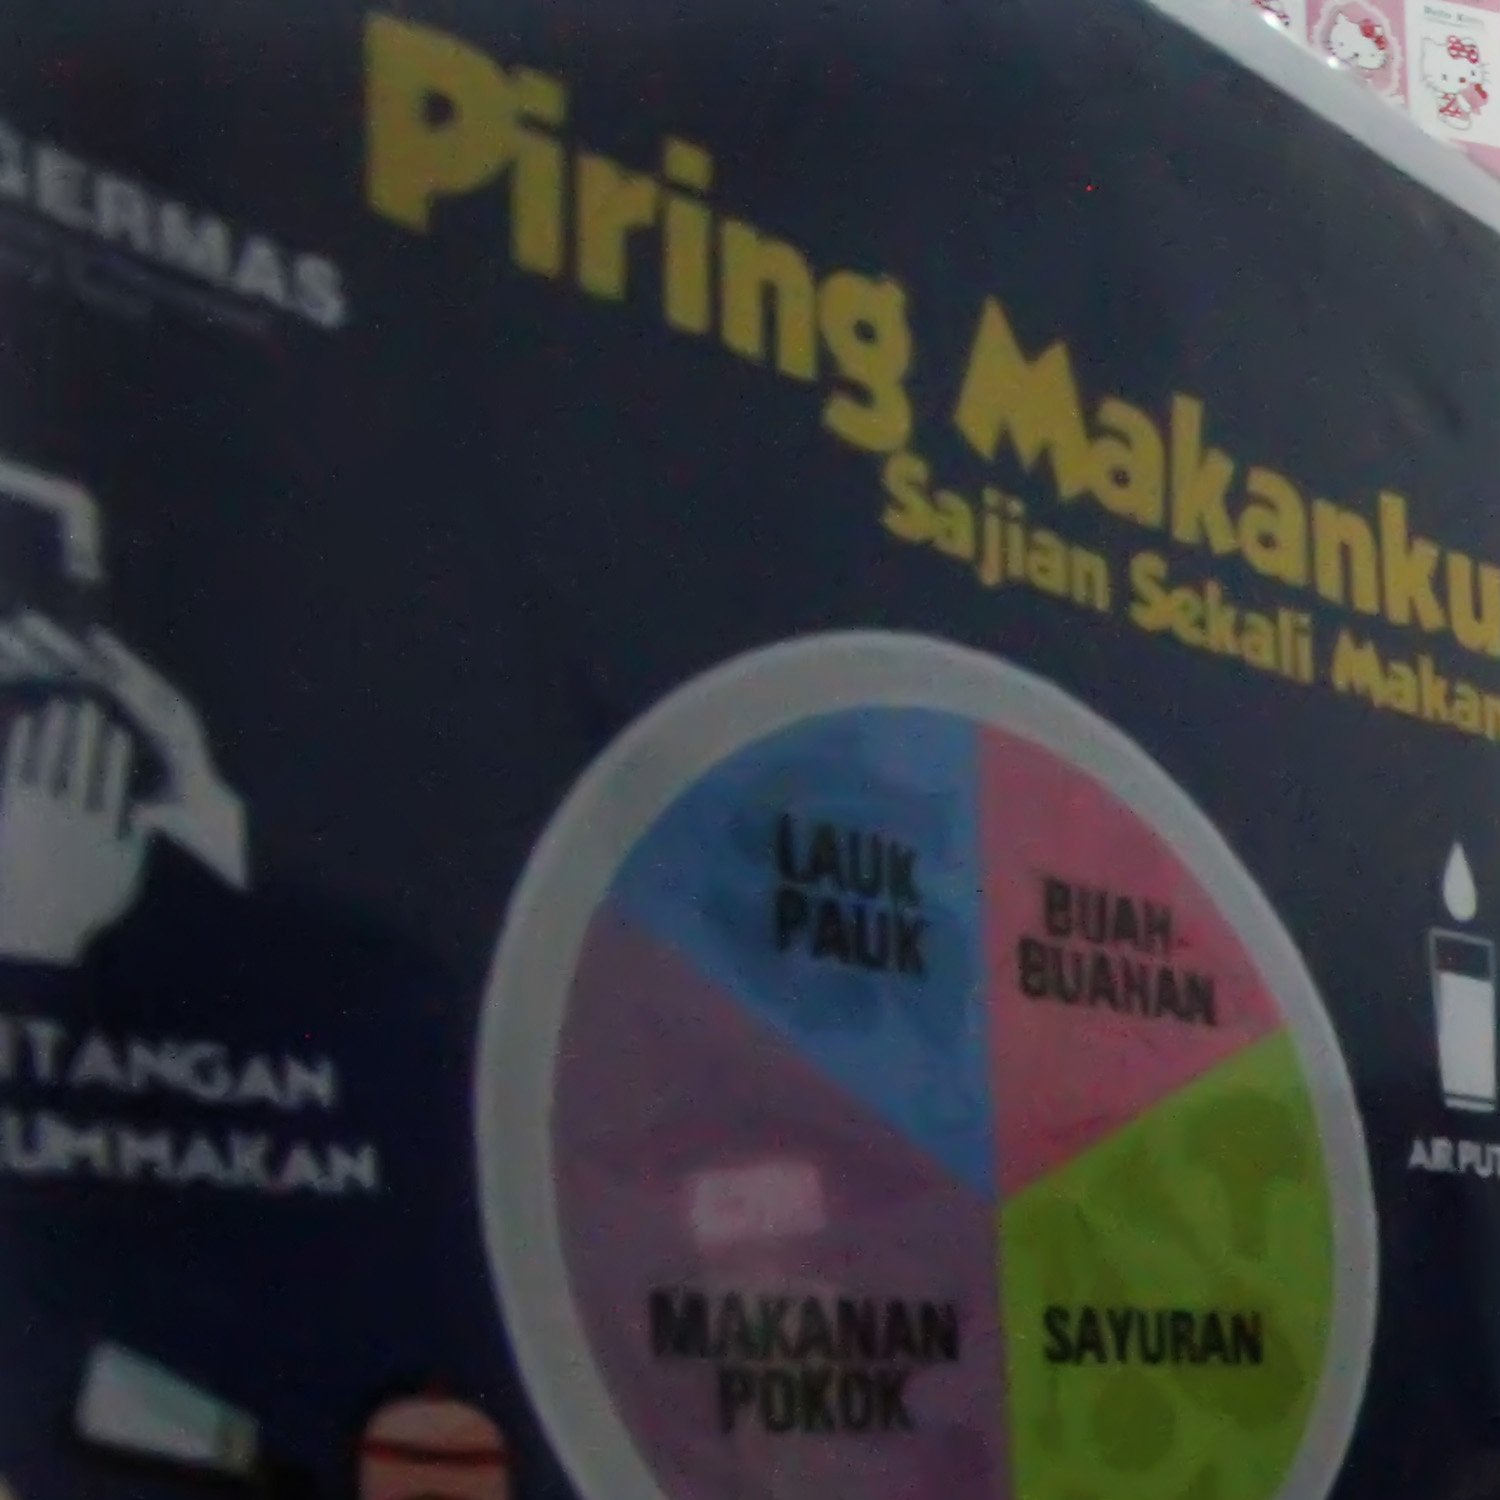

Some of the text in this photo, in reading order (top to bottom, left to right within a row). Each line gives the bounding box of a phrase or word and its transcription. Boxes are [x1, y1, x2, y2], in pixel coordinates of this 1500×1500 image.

[364, 10, 911, 452] Piring
[881, 453, 1111, 612] Sajian
[1129, 550, 1313, 685] Sekali
[774, 812, 921, 904] LAUK
[774, 888, 928, 976] PAUK
[1017, 936, 1219, 1026] BUAHAN
[649, 1281, 960, 1363] MAKANAN
[1042, 1304, 1264, 1367] SAYURAN
[716, 1363, 913, 1435] POKOK
